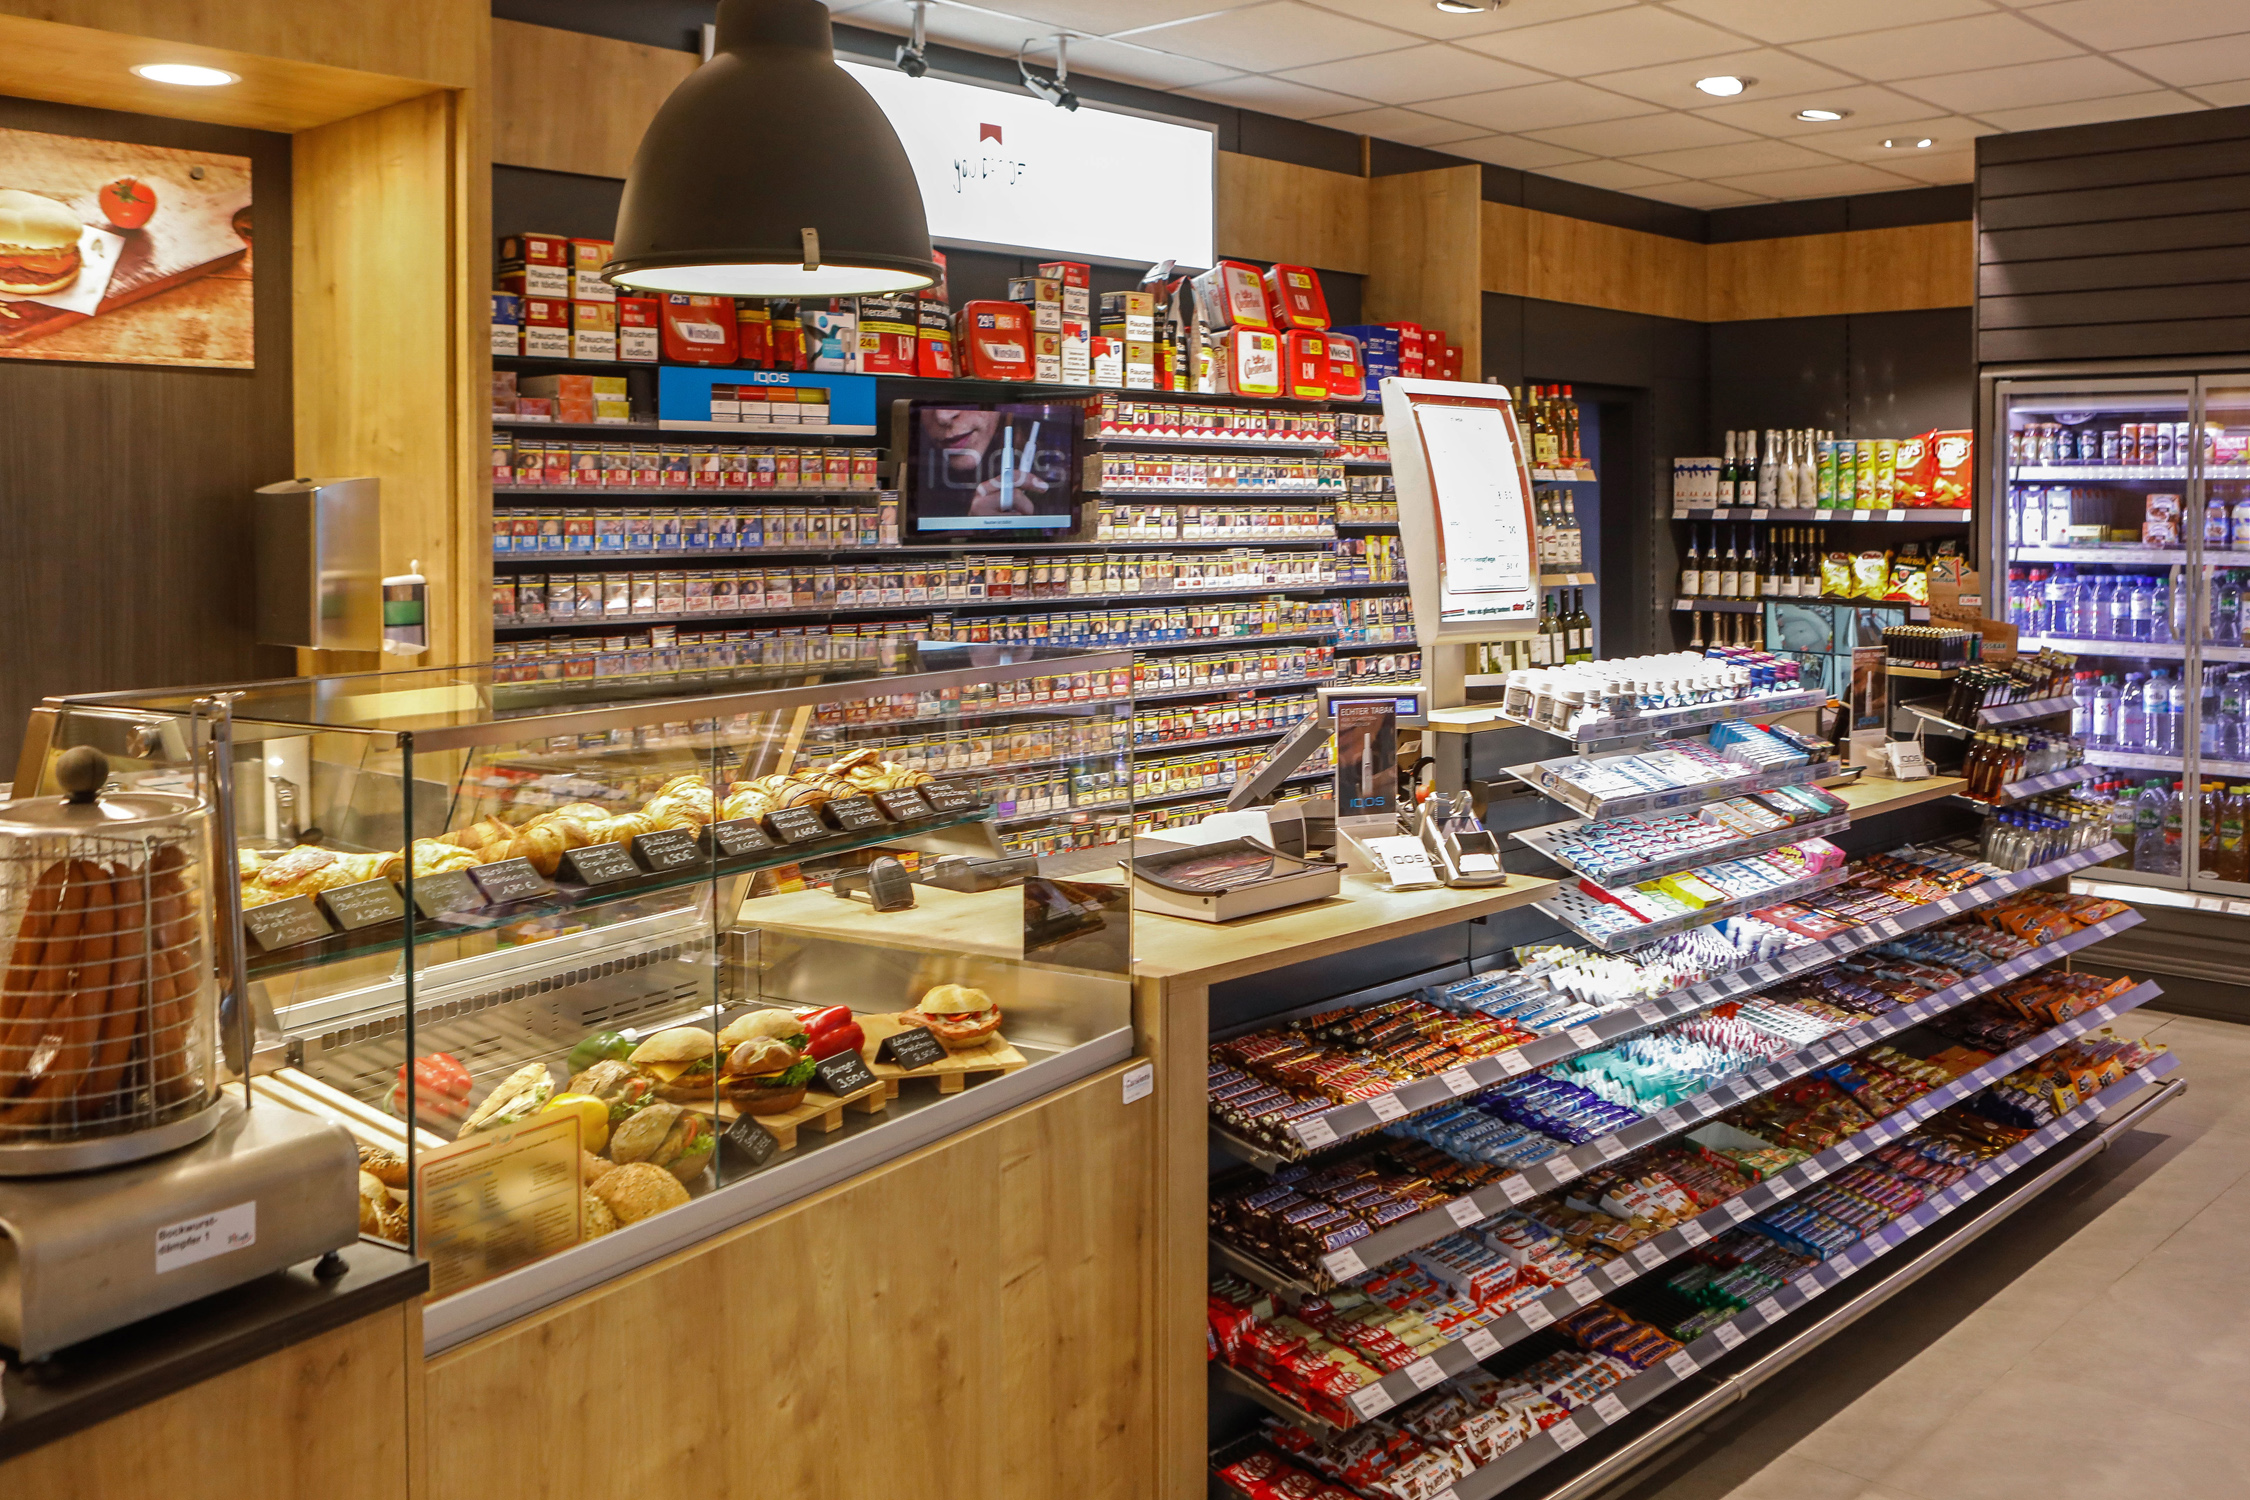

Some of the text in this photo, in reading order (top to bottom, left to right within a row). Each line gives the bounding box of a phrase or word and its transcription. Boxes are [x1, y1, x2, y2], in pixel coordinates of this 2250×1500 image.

[686, 324, 721, 340] Winston
[992, 345, 1021, 360] Winston
[1330, 346, 1352, 360] West
[753, 372, 790, 384] IQOS
[928, 447, 1067, 490] IQOS
[1340, 707, 1370, 717] ECHTER
[1370, 706, 1395, 715] TABAK
[1350, 796, 1385, 808] IQOS
[663, 849, 696, 866] 1,30€
[1390, 854, 1425, 866] IQOS
[593, 862, 635, 879] 1,30€
[836, 1072, 870, 1089] 3,50€
[1349, 1078, 1396, 1100] TWIX
[1325, 1221, 1370, 1250] SNICKERS
[1471, 1417, 1496, 1438] bueno
[1496, 1432, 1519, 1456] bueno
[1424, 1468, 1450, 1496] bueno
